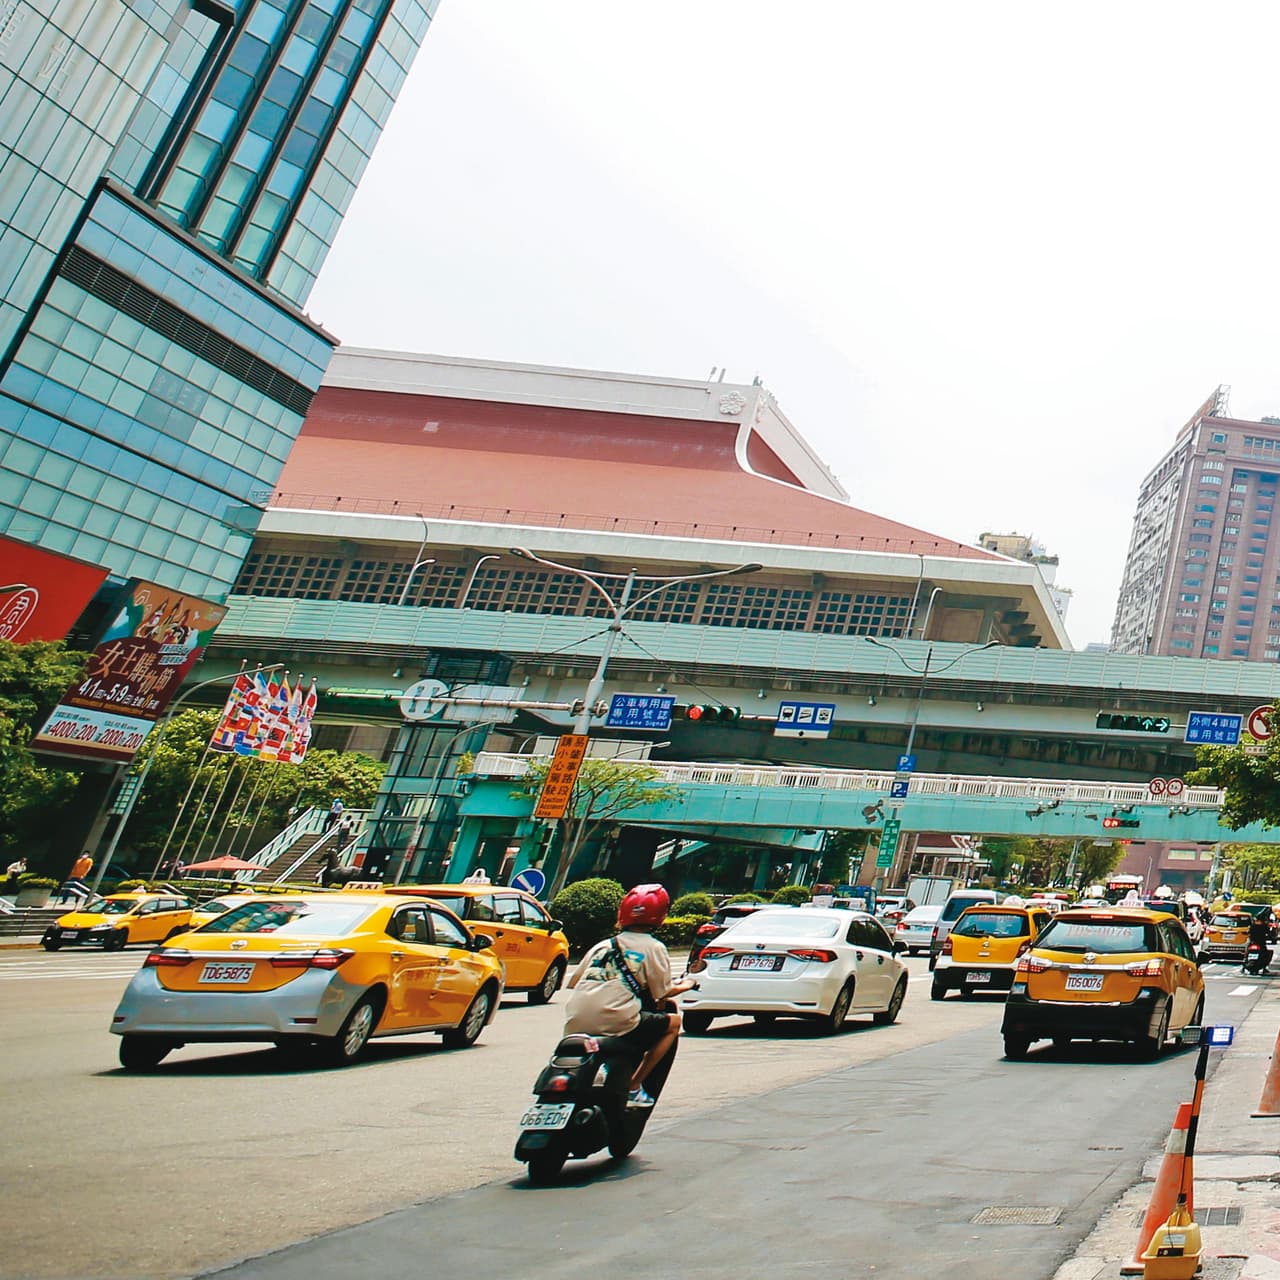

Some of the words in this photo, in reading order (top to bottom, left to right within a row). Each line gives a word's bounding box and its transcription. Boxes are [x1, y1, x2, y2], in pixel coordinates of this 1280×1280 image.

[615, 697, 672, 709] 公車專用道
[611, 708, 668, 720] 專用號誌
